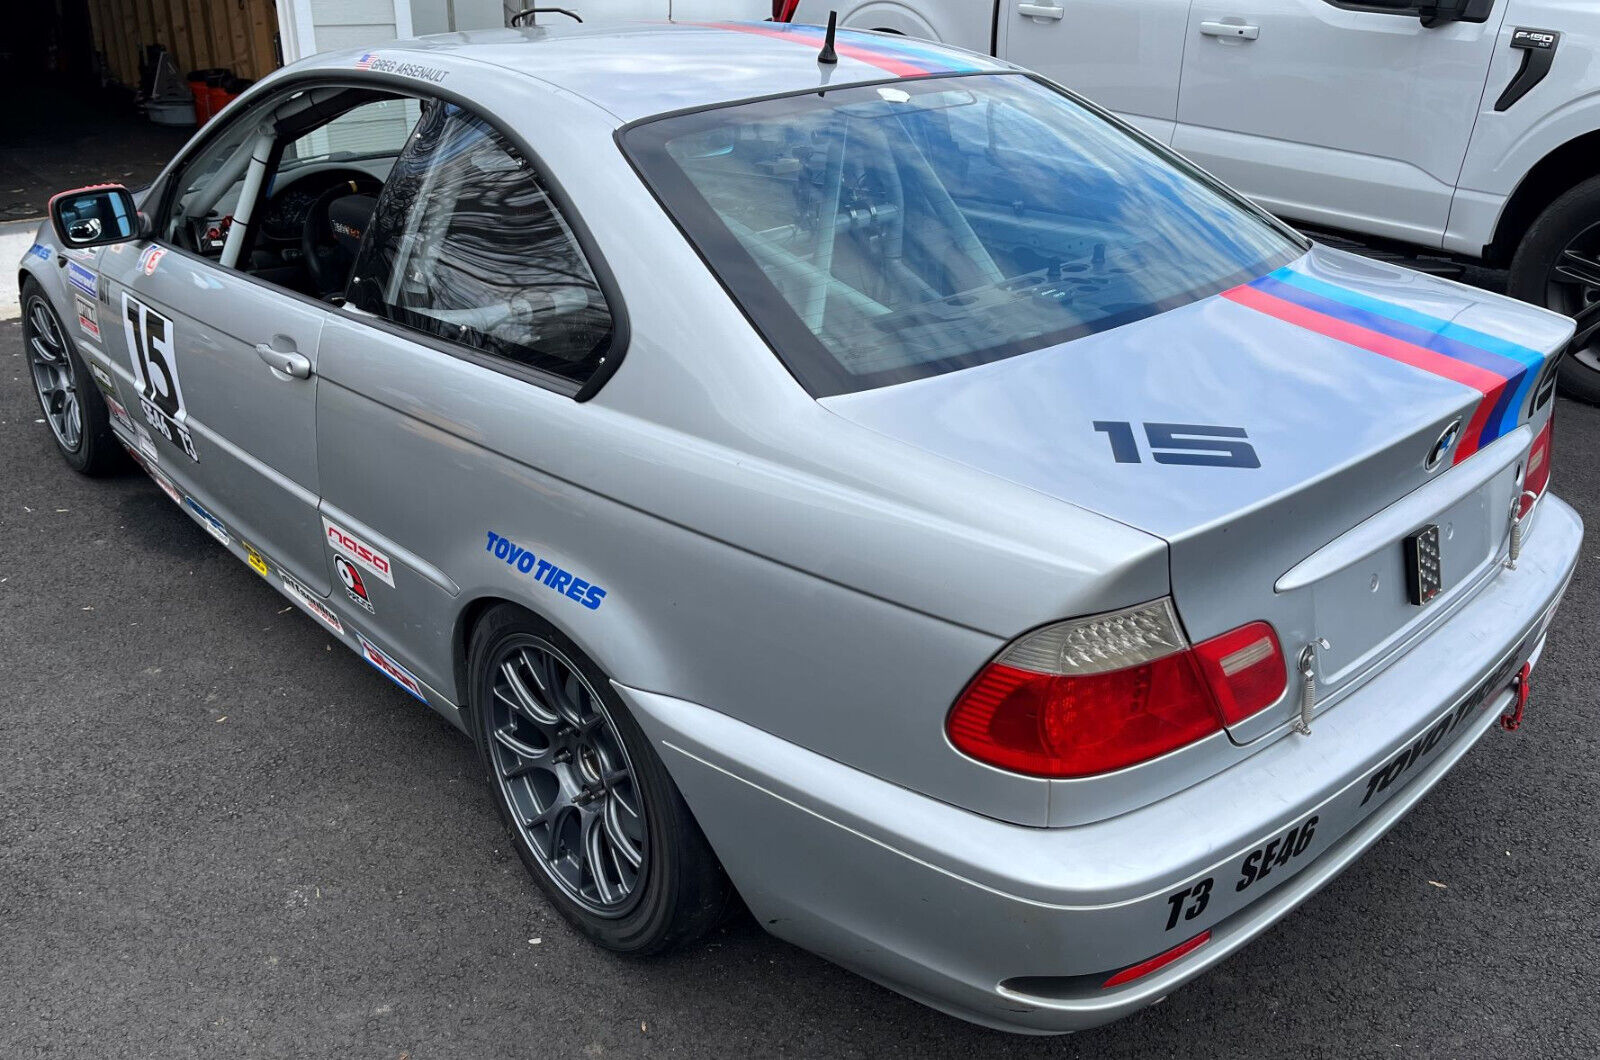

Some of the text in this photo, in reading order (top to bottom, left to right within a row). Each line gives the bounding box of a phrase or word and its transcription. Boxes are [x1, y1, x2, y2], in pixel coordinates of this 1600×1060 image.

[1515, 32, 1553, 42] F-150
[371, 59, 449, 82] GREG ARSENAULT
[127, 297, 180, 419] 15
[177, 427, 199, 461] T3
[1092, 420, 1262, 469] 15
[328, 527, 389, 574] nasa
[486, 531, 607, 610] TOYO TIRES
[1360, 713, 1454, 807] TOYO
[1165, 815, 1320, 932] T3 SE46
